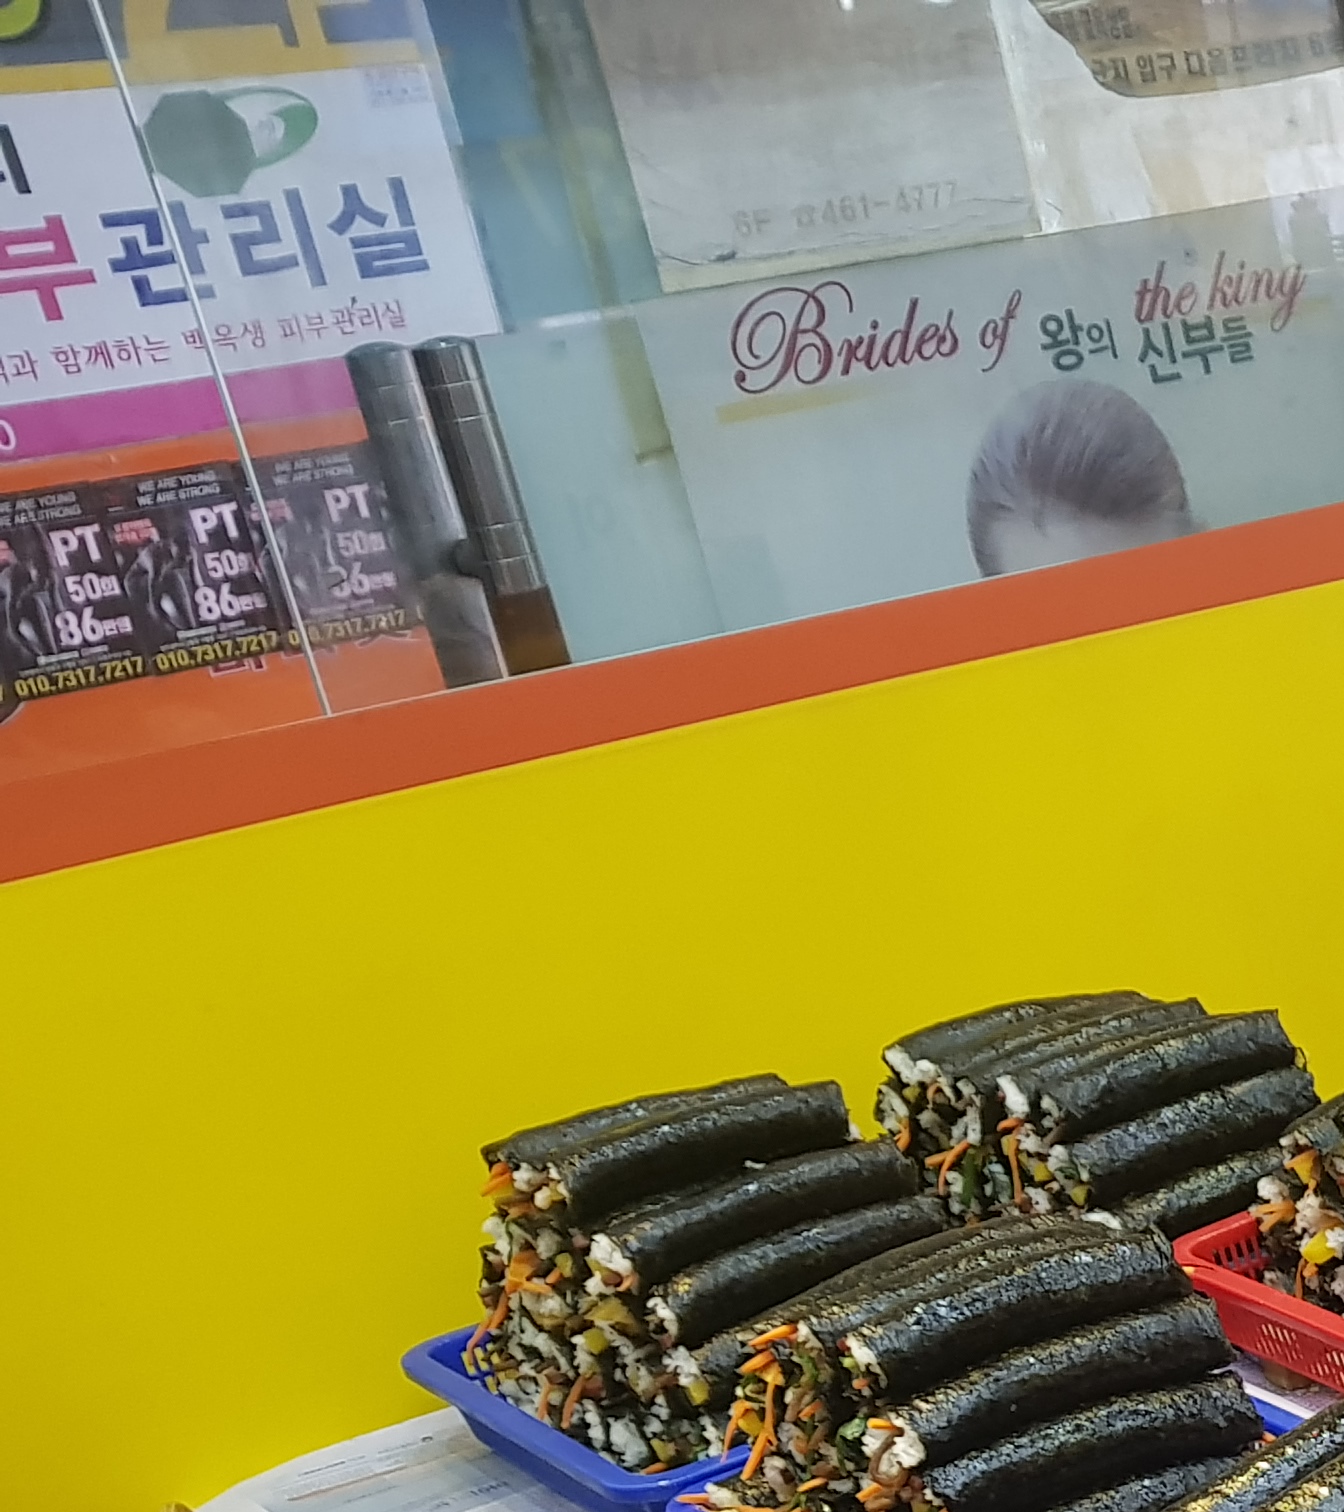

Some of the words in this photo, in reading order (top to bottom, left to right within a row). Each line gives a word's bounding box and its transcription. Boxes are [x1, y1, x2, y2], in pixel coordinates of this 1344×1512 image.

[0, 349, 40, 384] 과
[52, 335, 172, 376] 함께하는
[278, 300, 408, 341] 피부관리실
[730, 280, 960, 394] Brides
[978, 289, 1023, 373] of
[1134, 260, 1197, 325] the
[1207, 250, 1309, 332] king
[1038, 307, 1120, 373] 왕의
[1137, 314, 1255, 385] 신부들
[136, 493, 154, 507] WE
[155, 488, 177, 504] ARE
[137, 480, 155, 494] WE
[156, 474, 178, 490] ARE
[324, 483, 370, 523] PT
[49, 522, 101, 567] PT
[189, 501, 239, 546] PT
[156, 630, 281, 673] 010.7317.7217
[14, 656, 145, 698] 010.7317.7217
